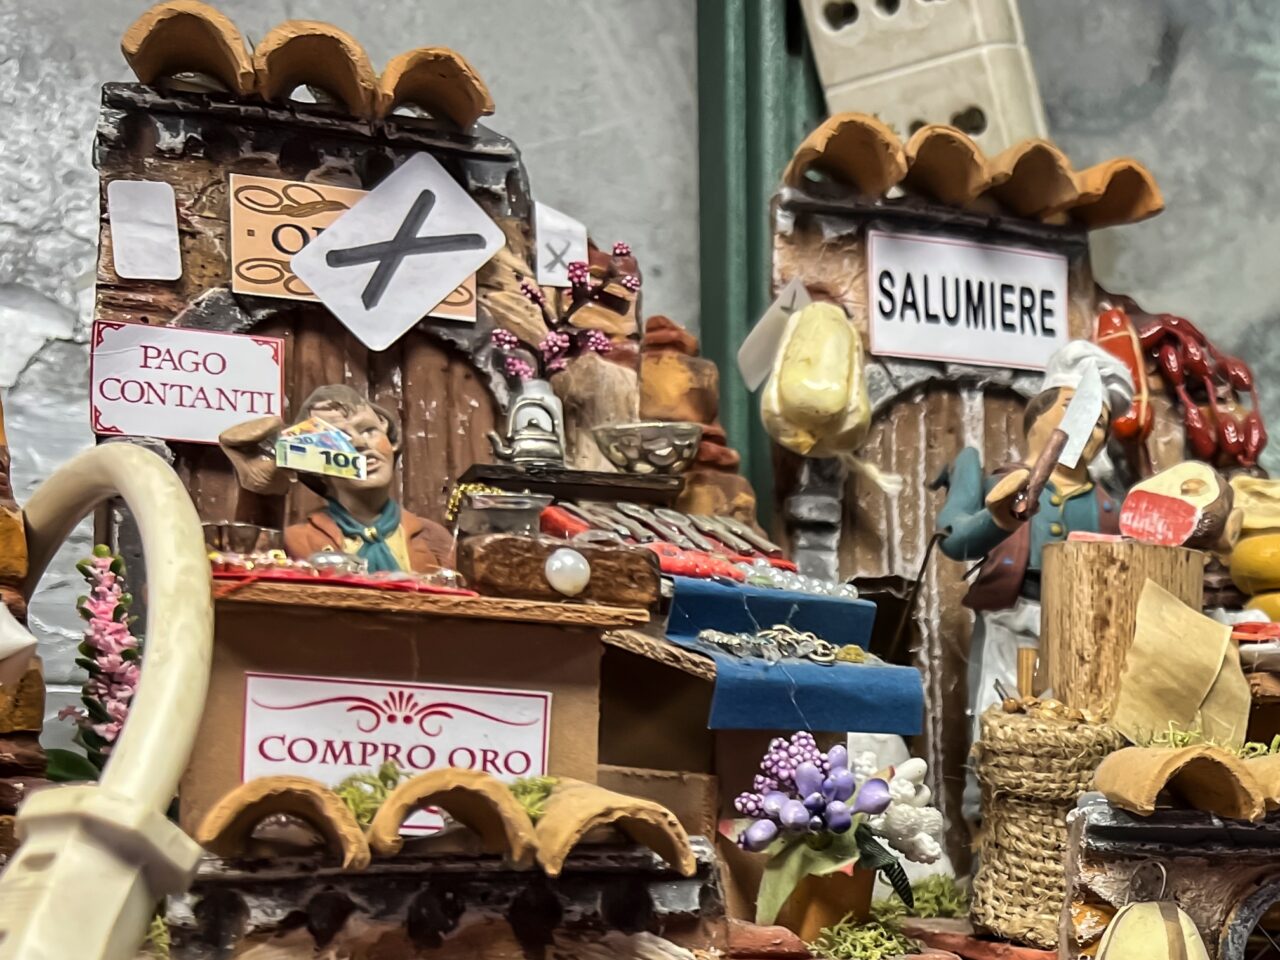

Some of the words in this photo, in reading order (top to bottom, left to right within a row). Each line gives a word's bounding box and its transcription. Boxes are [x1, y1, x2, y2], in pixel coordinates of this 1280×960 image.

[878, 269, 1057, 338] SALUMIERE
[139, 345, 227, 375] PAGO
[99, 377, 275, 415] CONTANTI
[258, 734, 436, 770] COMPRO
[448, 747, 532, 775] ORO
